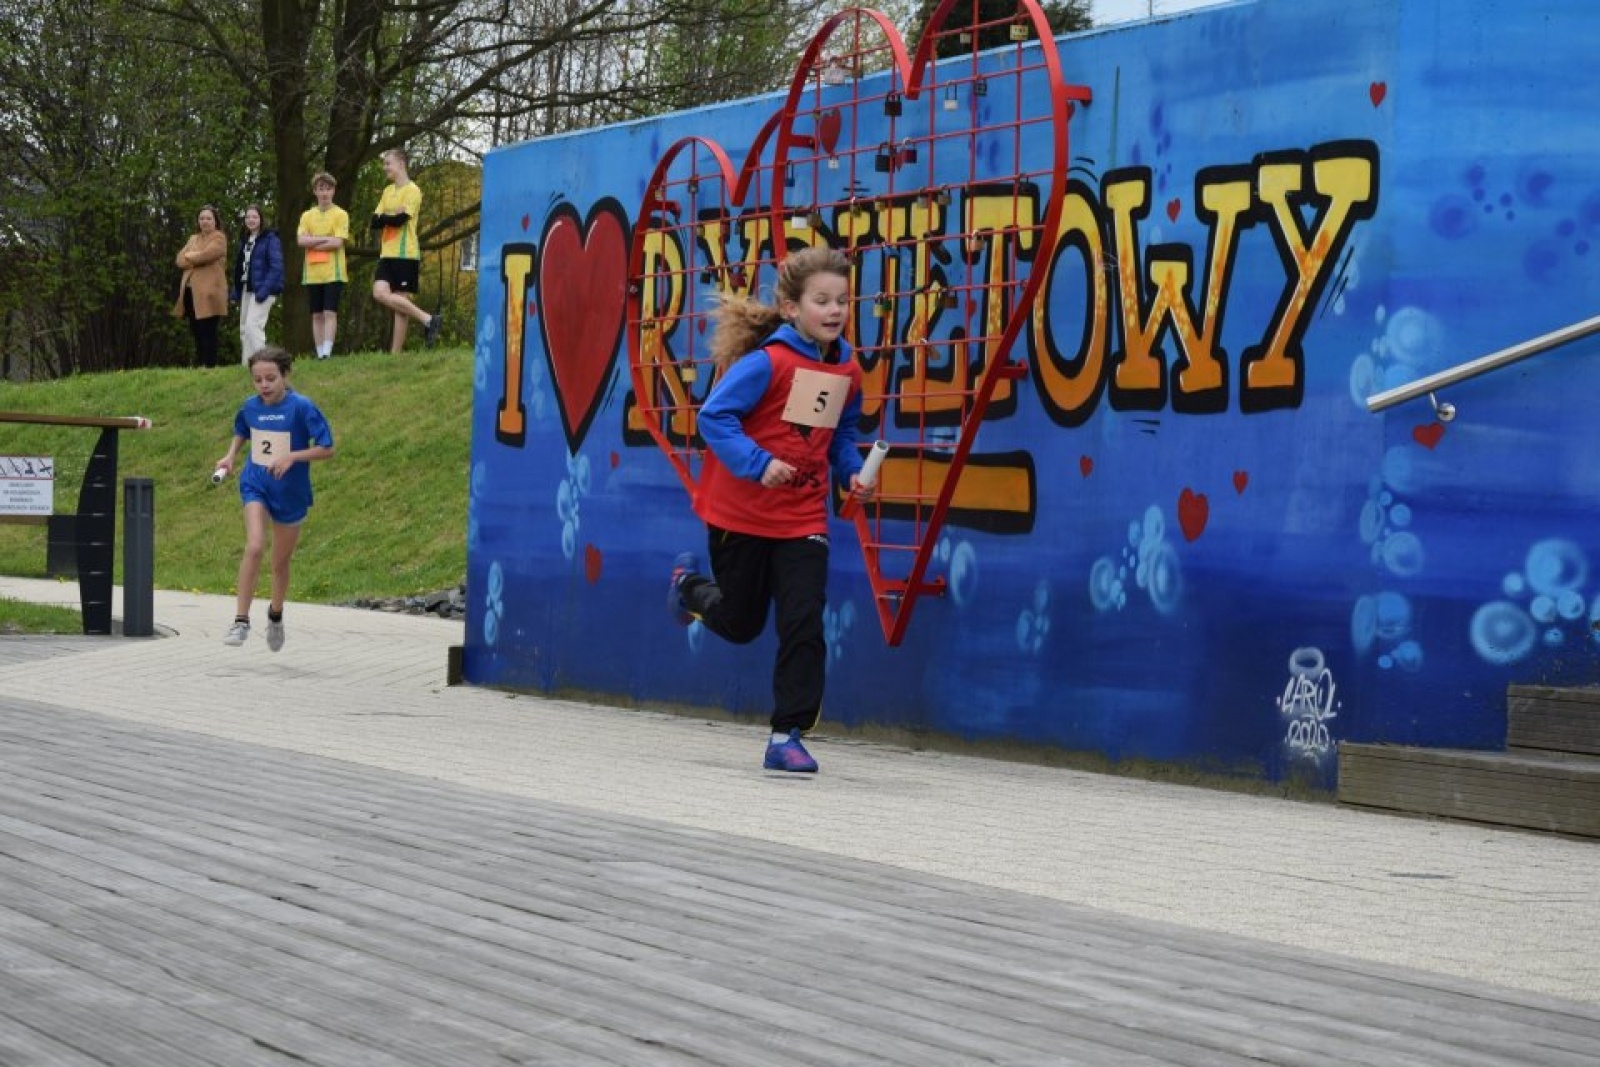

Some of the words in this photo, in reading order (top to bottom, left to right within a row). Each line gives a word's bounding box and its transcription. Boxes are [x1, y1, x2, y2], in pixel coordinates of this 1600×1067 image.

[496, 242, 537, 448] I
[813, 390, 830, 414] 5
[261, 440, 273, 455] 2
